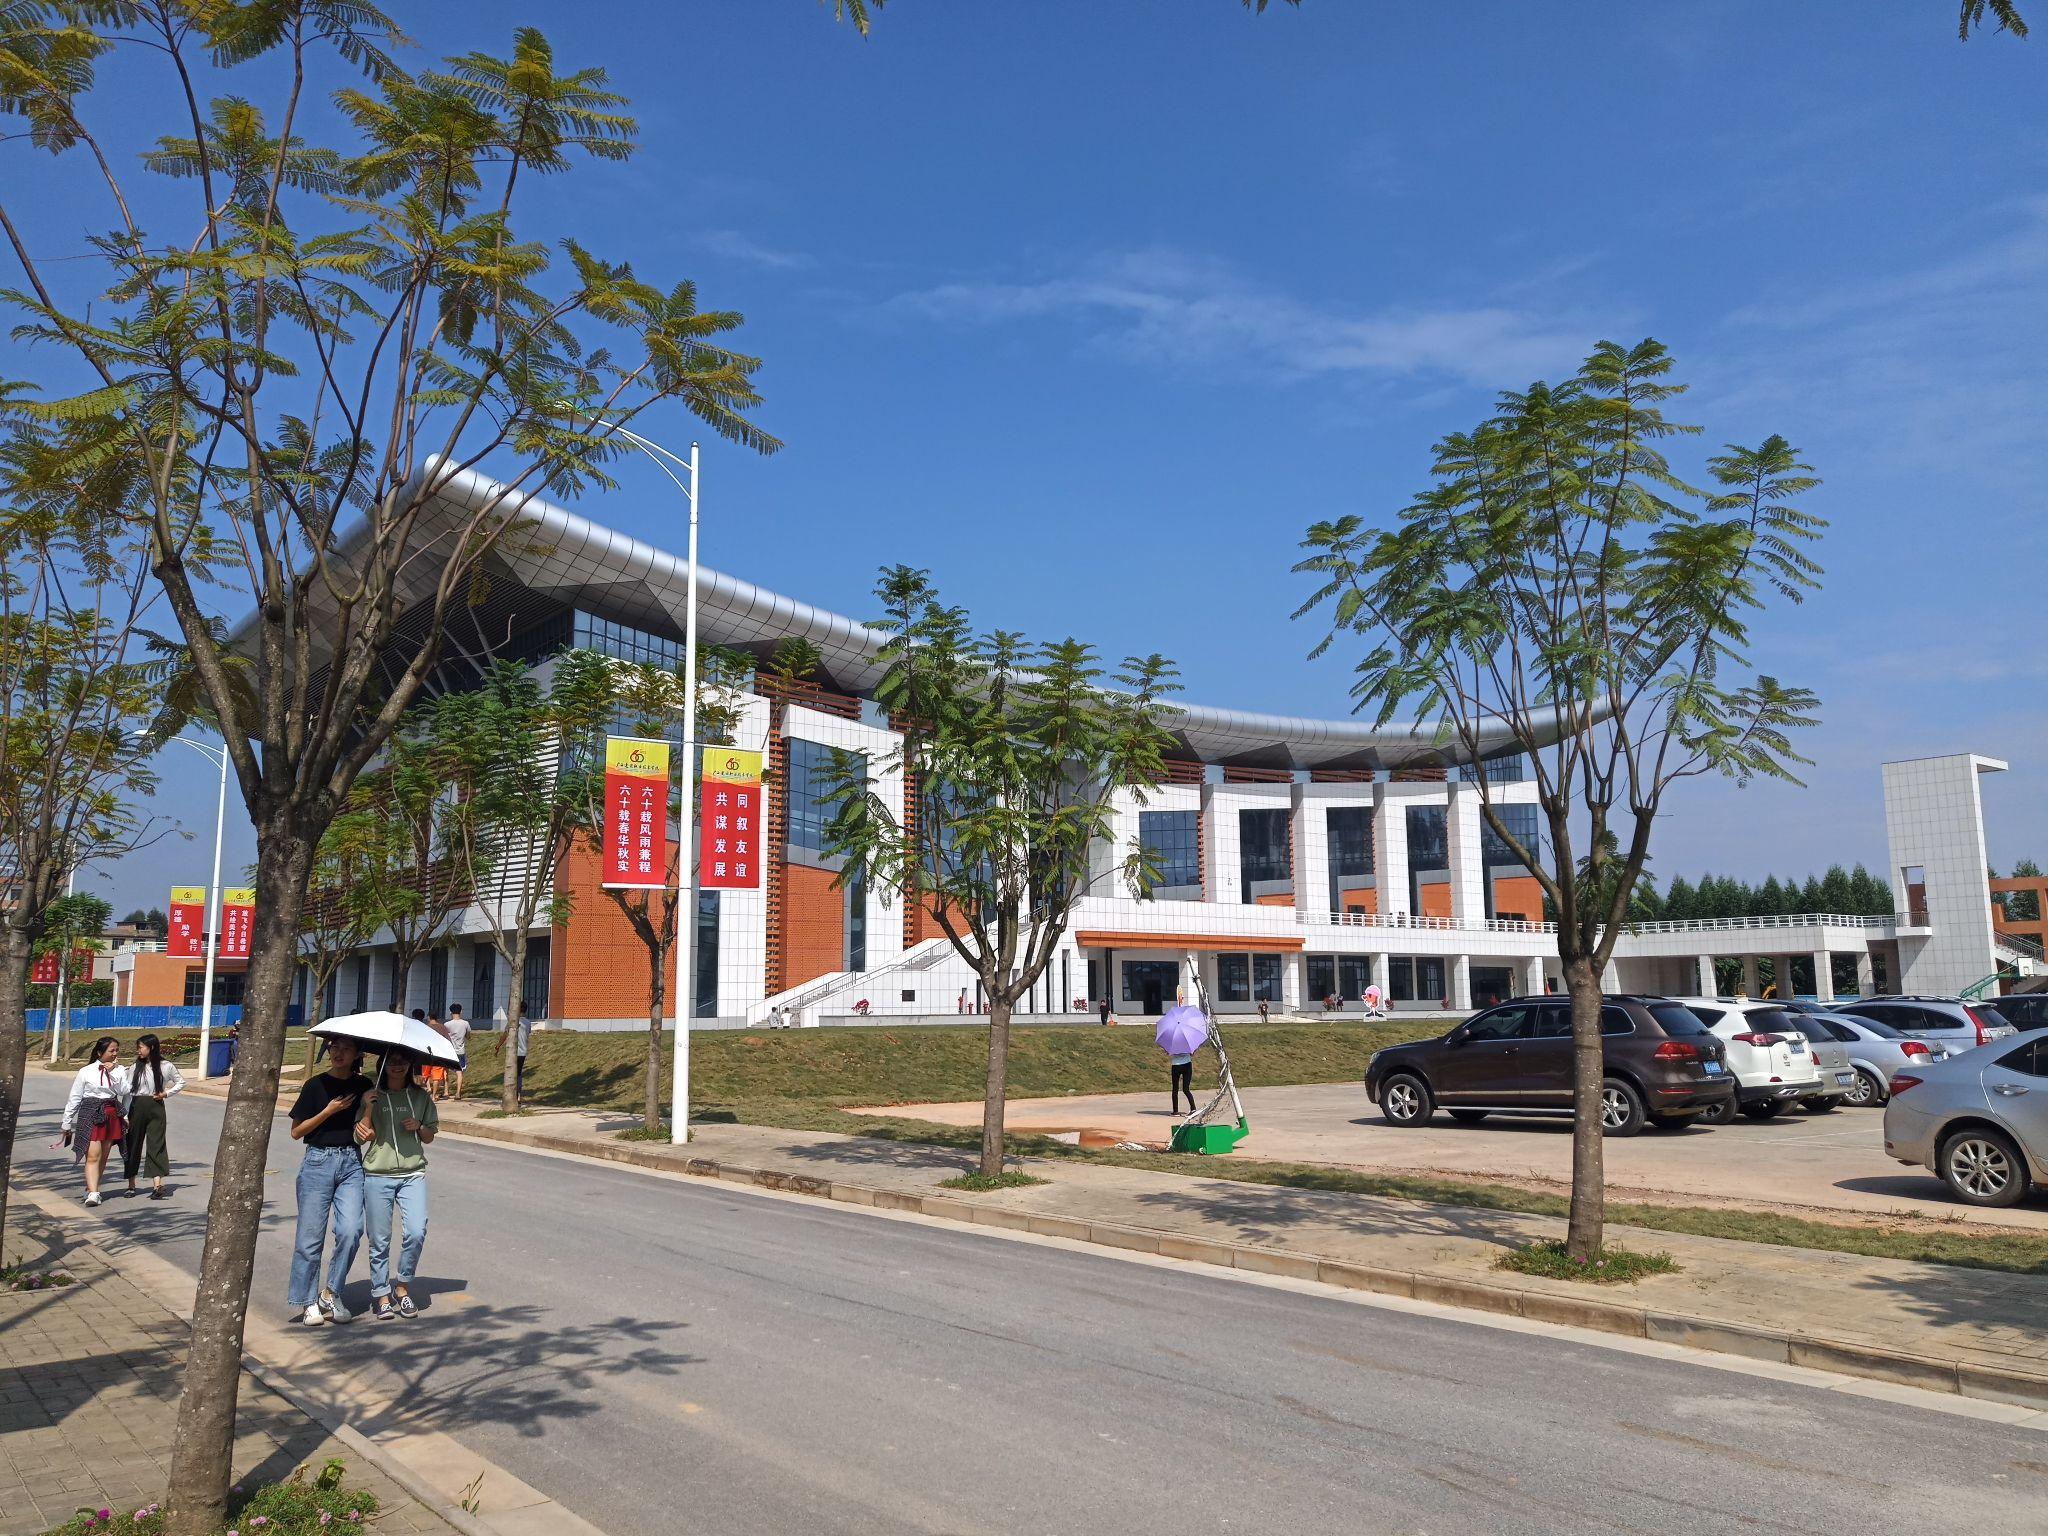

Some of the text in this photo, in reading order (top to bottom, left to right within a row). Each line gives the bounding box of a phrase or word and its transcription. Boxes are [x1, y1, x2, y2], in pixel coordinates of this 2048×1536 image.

[617, 785, 630, 872] 六十载春华秋实
[639, 787, 652, 873] 六十载风雨兼程
[714, 792, 728, 877] 共谋发展
[735, 793, 748, 877] 同叙友谊
